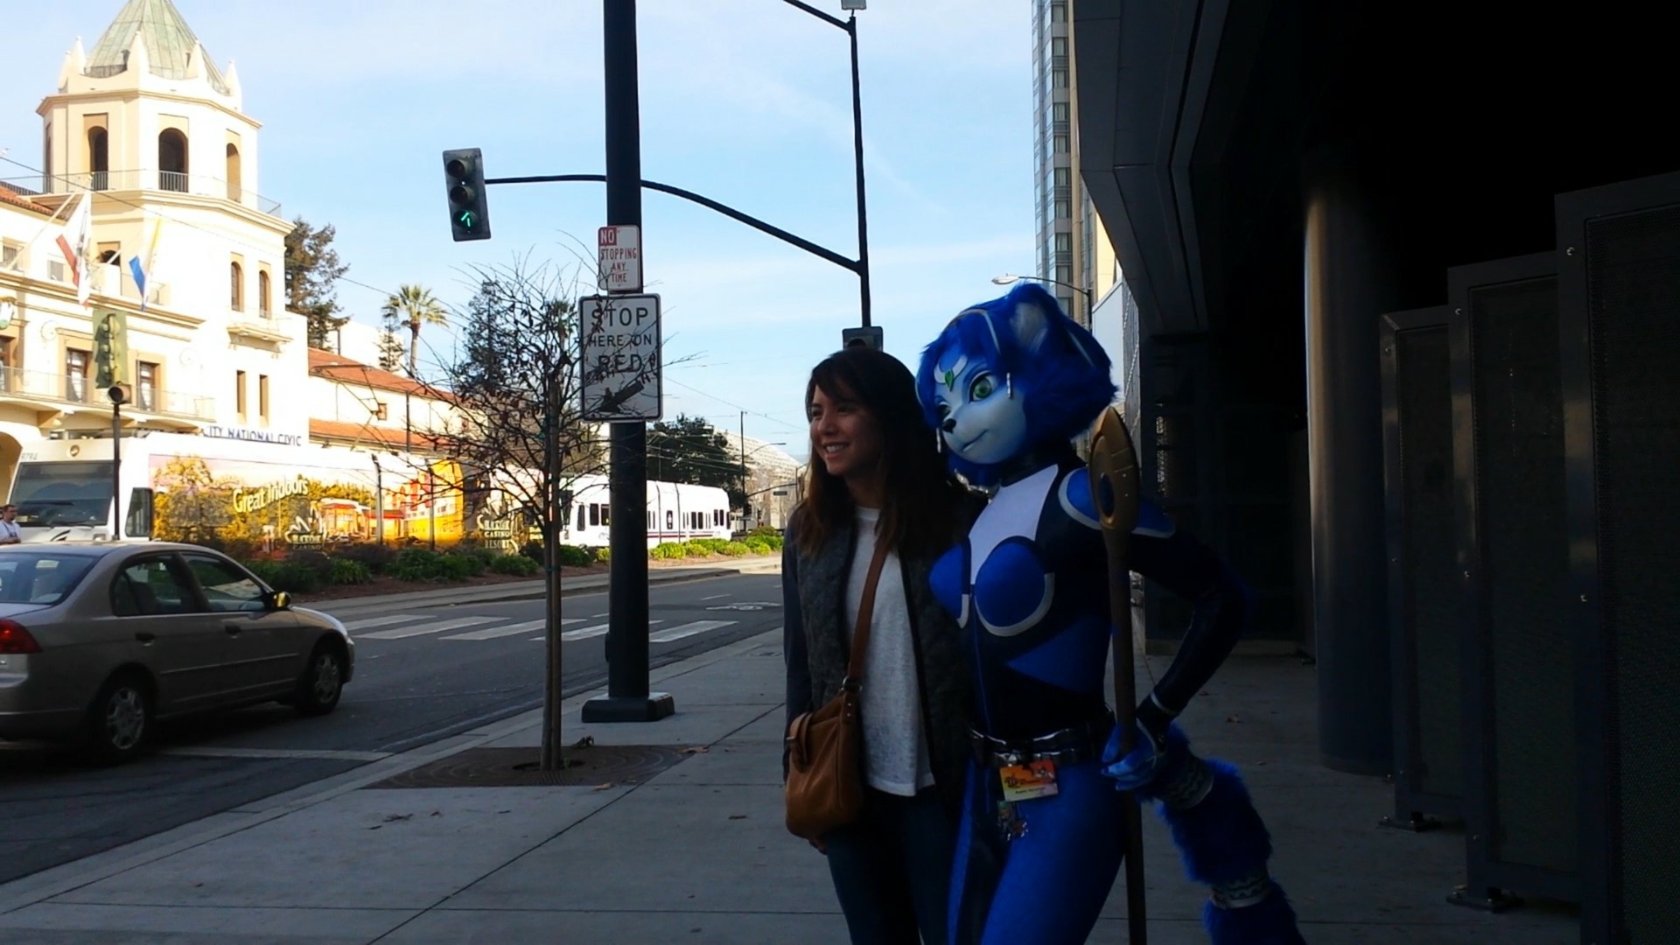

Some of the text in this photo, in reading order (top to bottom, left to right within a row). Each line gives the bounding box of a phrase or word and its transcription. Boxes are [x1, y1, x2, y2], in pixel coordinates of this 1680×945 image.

[601, 228, 615, 244] NO
[600, 248, 637, 260] STOPPING
[611, 262, 626, 272] ANY
[611, 273, 627, 283] TIME
[591, 307, 649, 327] STOP
[588, 334, 652, 348] HERE ON
[598, 354, 643, 372] RED
[233, 478, 309, 513] Great Indoors
